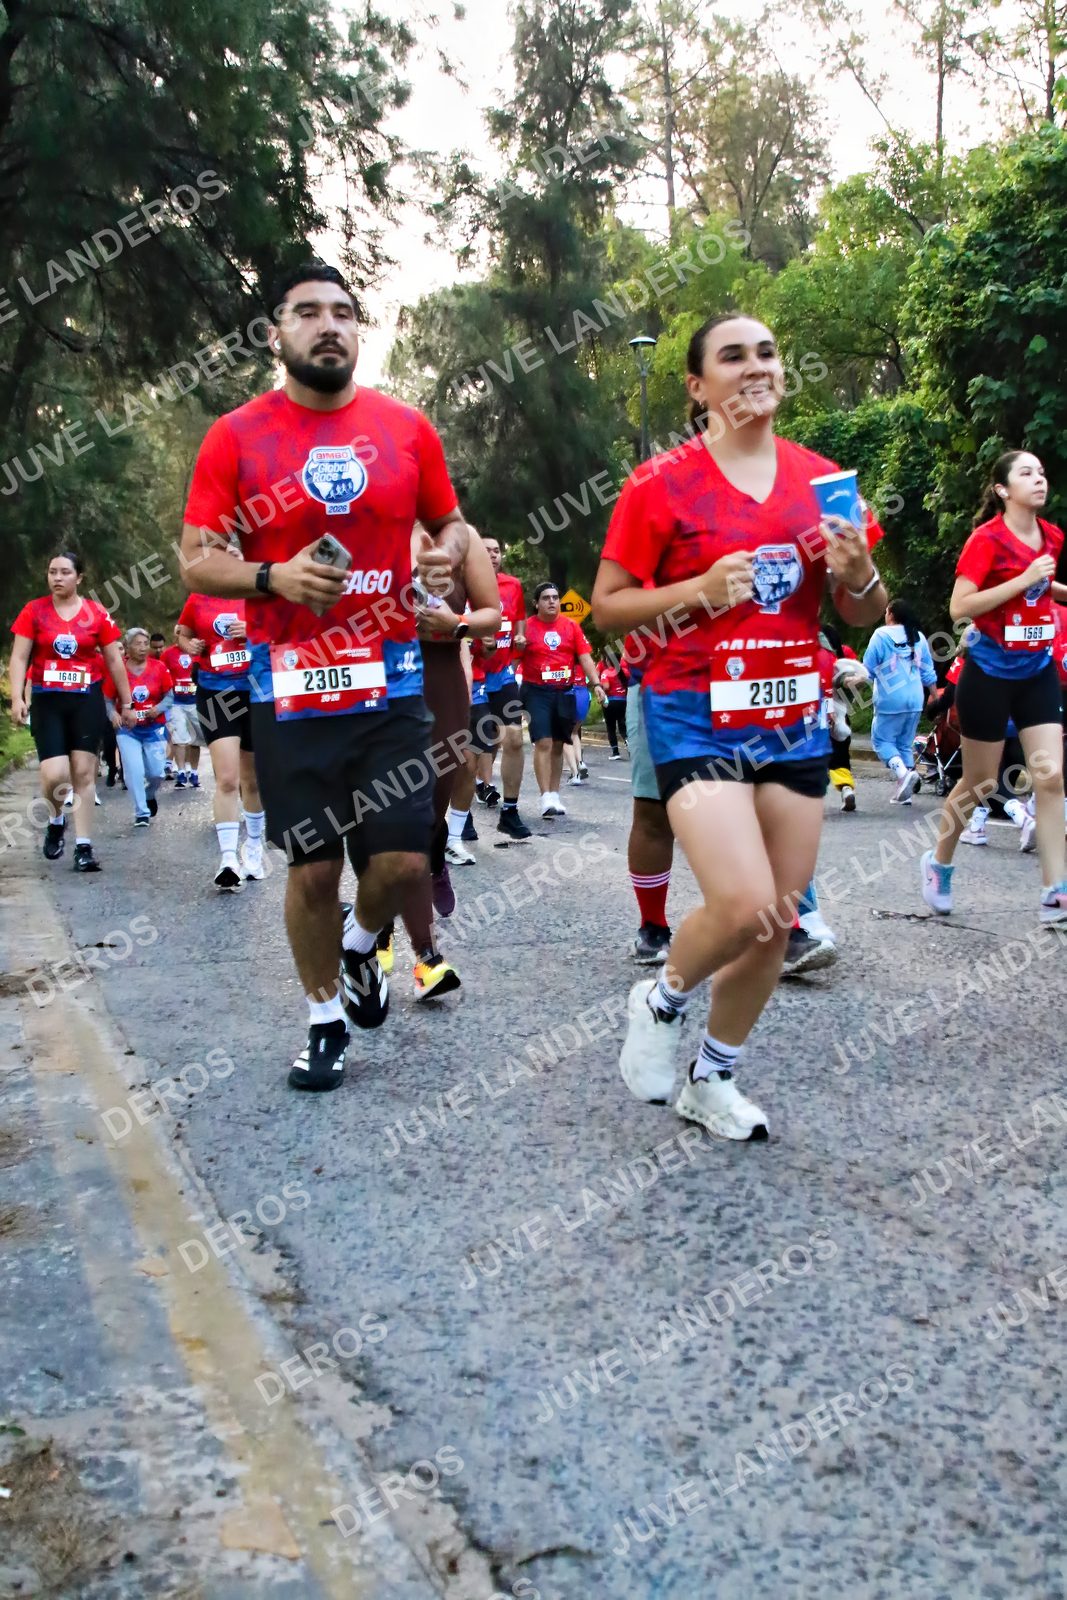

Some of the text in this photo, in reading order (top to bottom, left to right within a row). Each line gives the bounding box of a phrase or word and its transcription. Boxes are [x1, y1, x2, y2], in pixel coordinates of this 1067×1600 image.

[318, 462, 349, 473] Global
[312, 472, 339, 482] Race
[328, 504, 348, 514] 2026
[1023, 626, 1043, 640] 1569
[225, 651, 247, 663] 1938
[58, 672, 78, 682] 1648
[303, 667, 352, 692] 2305
[750, 678, 797, 706] 2306
